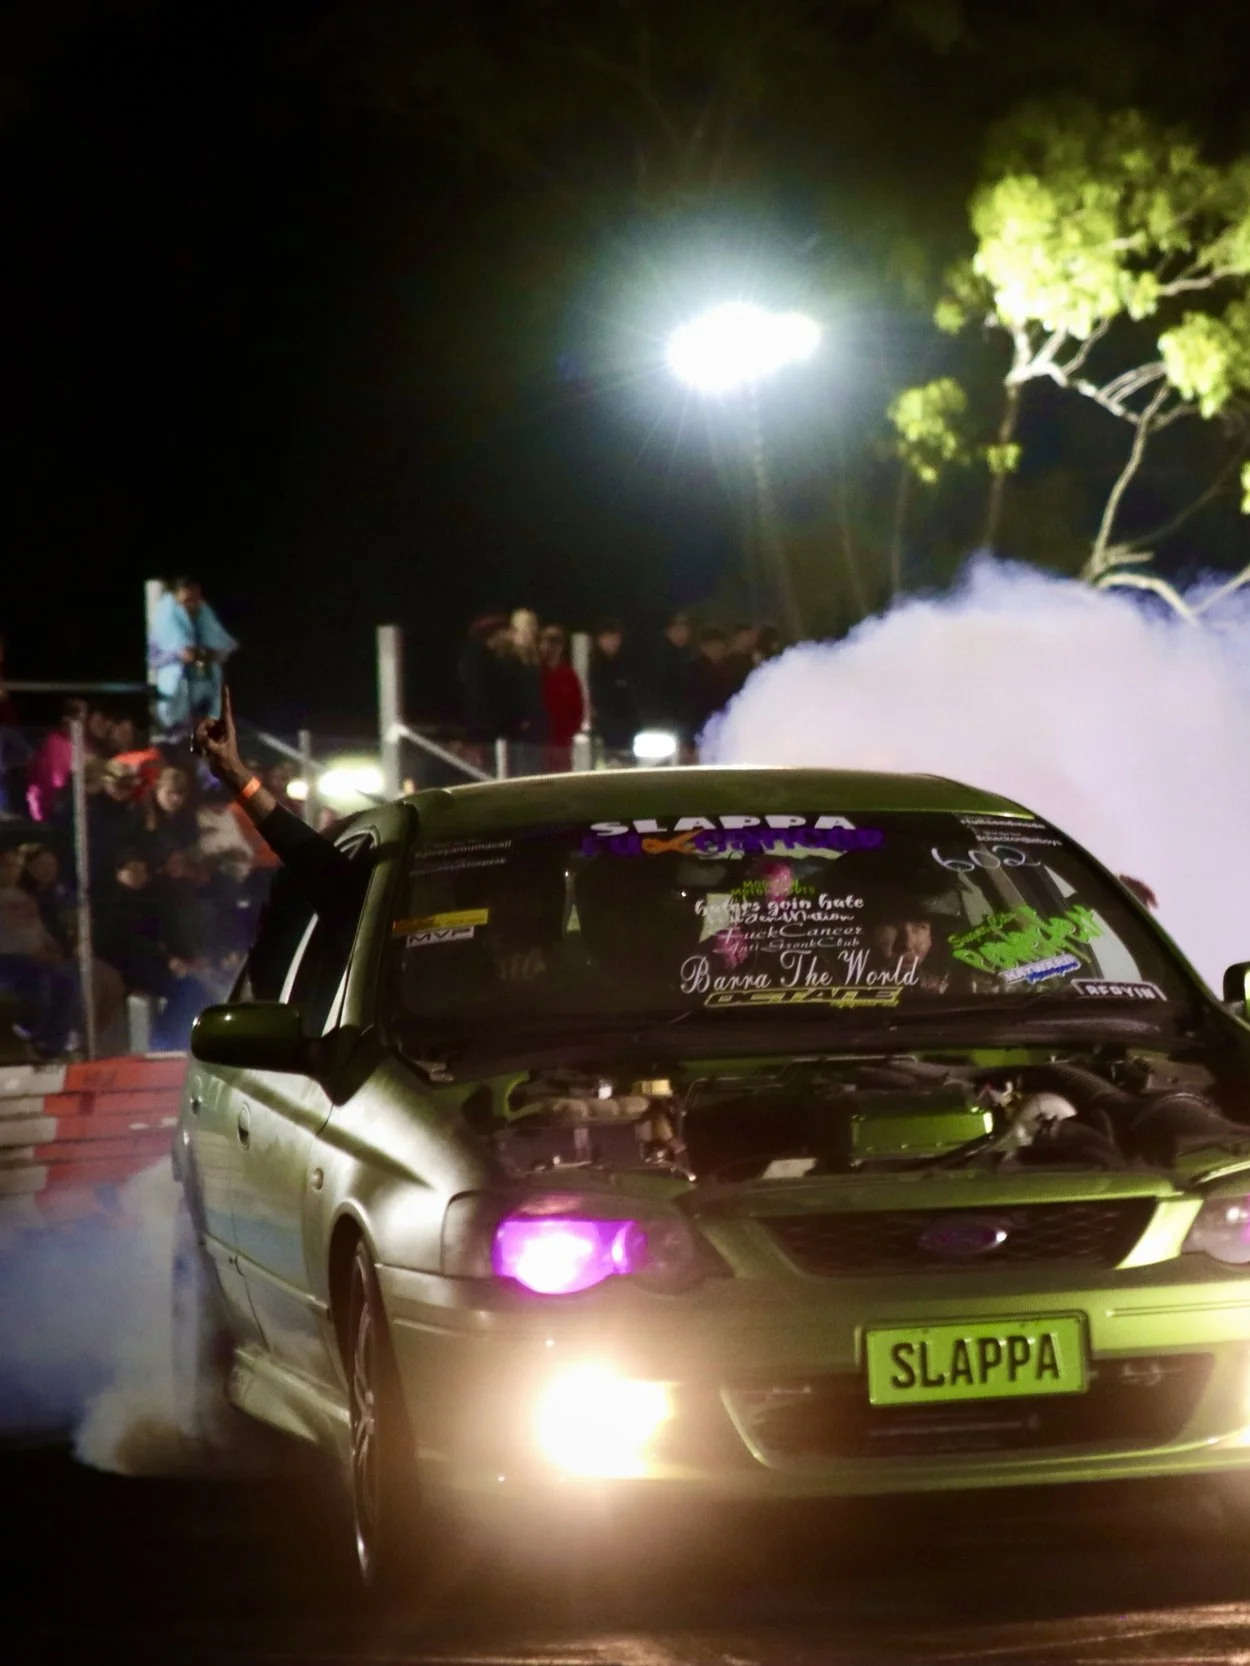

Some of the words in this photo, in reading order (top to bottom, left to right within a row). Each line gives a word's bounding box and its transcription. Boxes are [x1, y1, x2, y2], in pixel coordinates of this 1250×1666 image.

[590, 814, 857, 836] SLAPPA
[767, 896, 812, 917] goin
[818, 892, 864, 910] hate
[408, 928, 471, 944] MVP
[679, 954, 771, 994] Barra
[779, 950, 833, 989] The
[837, 948, 919, 988] World
[891, 1332, 1062, 1389] SLAPPA
